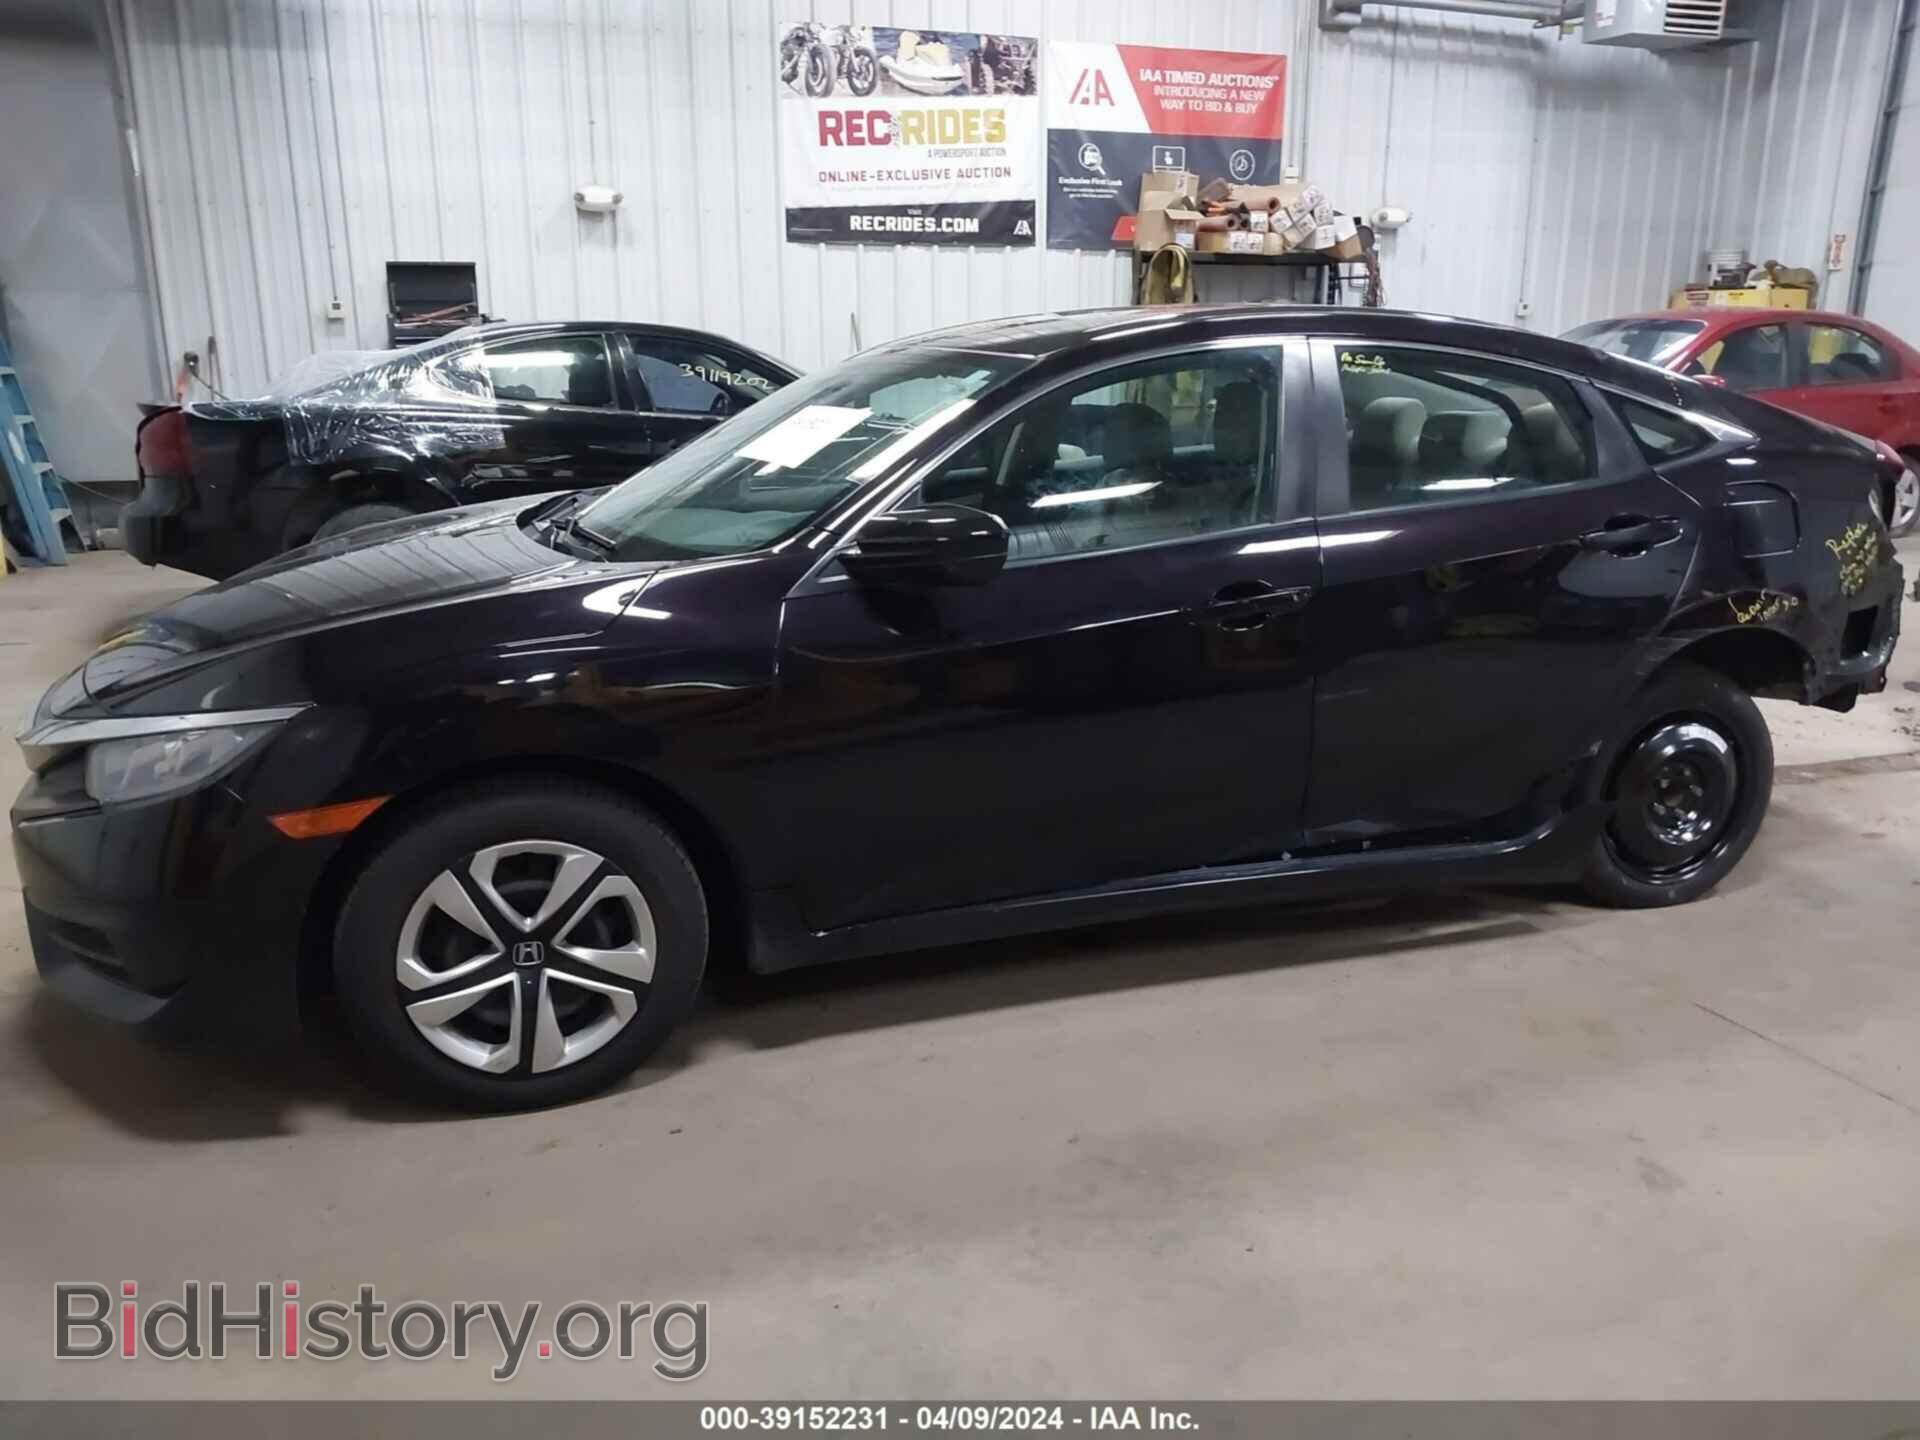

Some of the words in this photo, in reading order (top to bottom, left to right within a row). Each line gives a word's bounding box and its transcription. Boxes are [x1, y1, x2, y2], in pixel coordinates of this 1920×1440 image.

[1140, 69, 1161, 82] IAA
[1163, 70, 1205, 85] TIMED
[1153, 84, 1227, 100] INTRODUCING
[1229, 89, 1239, 100] A
[1240, 90, 1268, 102] NEW
[1160, 99, 1185, 111] WAY
[1188, 100, 1203, 111] TO
[1205, 101, 1222, 112] BID
[1224, 101, 1233, 113] &
[1235, 102, 1258, 114] BUY
[818, 110, 892, 146] REC
[902, 108, 1006, 145] RIDES
[819, 167, 951, 183] ONLINE-EXCLUSIVE
[957, 166, 1012, 179] AUCTION
[850, 215, 980, 233] RECRIDES.COM
